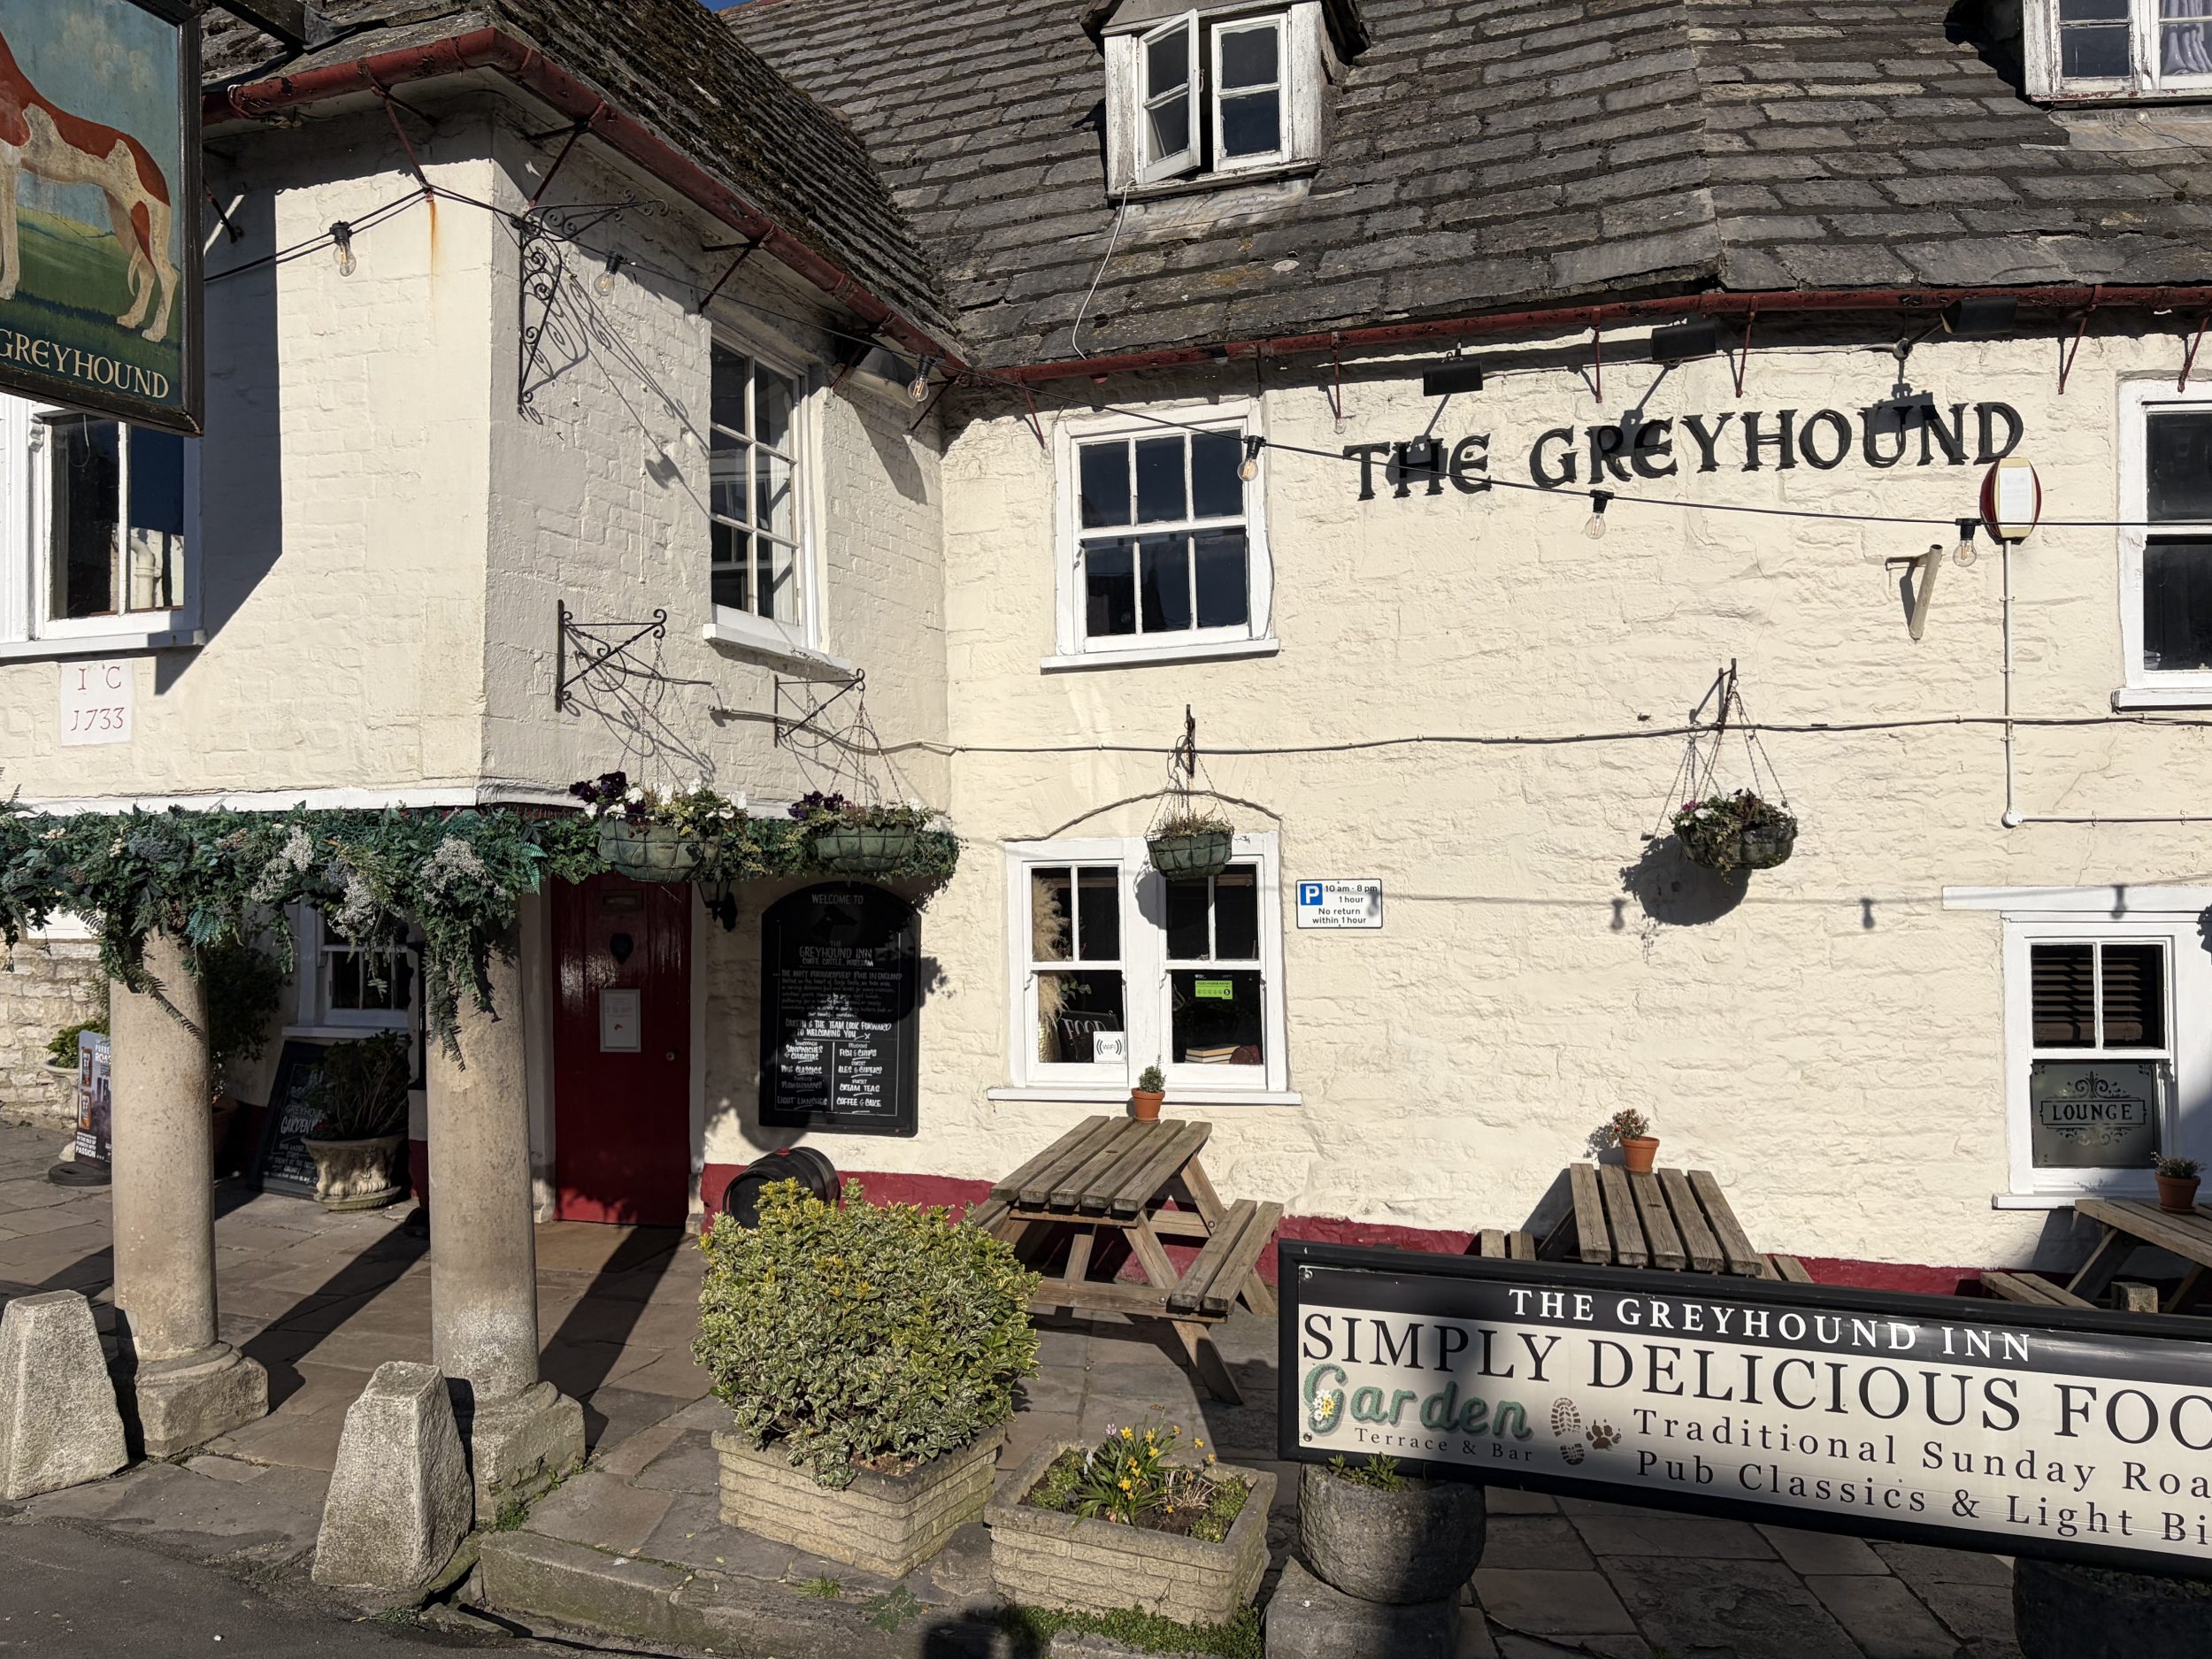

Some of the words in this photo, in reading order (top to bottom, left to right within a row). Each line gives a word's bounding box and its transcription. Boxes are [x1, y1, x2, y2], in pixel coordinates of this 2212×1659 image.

[0, 328, 169, 398] GREYHOUND
[1342, 434, 1491, 501] THE
[1530, 402, 2024, 488] GREYHOUND
[106, 666, 121, 688] C
[811, 894, 850, 904] WELCOME
[854, 895, 864, 904] TO
[1305, 886, 1319, 903] P
[799, 946, 852, 959] GREYHOUND
[856, 948, 872, 959] INN
[806, 1028, 841, 1038] WELCOMING
[843, 1029, 856, 1039] YOU
[814, 1019, 826, 1029] THE
[829, 1021, 844, 1030] TEAM
[846, 1021, 859, 1030] LOOK
[861, 1022, 892, 1032] FORWARD
[857, 1048, 878, 1057] CHIPS
[795, 1065, 823, 1074] CLASSICS
[839, 1083, 861, 1092] CREAM
[836, 1097, 858, 1106] COFFEE
[2053, 1103, 2132, 1120] LOUNGE
[1508, 1288, 1594, 1322] THE
[1617, 1297, 1917, 1350] GREYHOUND
[1942, 1326, 2030, 1362] INN
[1303, 1313, 1562, 1382] SIMPLY
[1586, 1339, 2020, 1431] DELICIOUS
[1303, 1363, 1532, 1440] Garden
[1354, 1426, 1448, 1451] Terrace
[1463, 1440, 1478, 1455] &
[1492, 1443, 1533, 1463] Bar
[1633, 1408, 1896, 1465] Traditional
[1922, 1440, 2096, 1493] Sunday
[1636, 1449, 1714, 1486] Pub
[1738, 1463, 1926, 1512] Classics
[1951, 1489, 1980, 1519] &
[2006, 1494, 2133, 1538] Light
